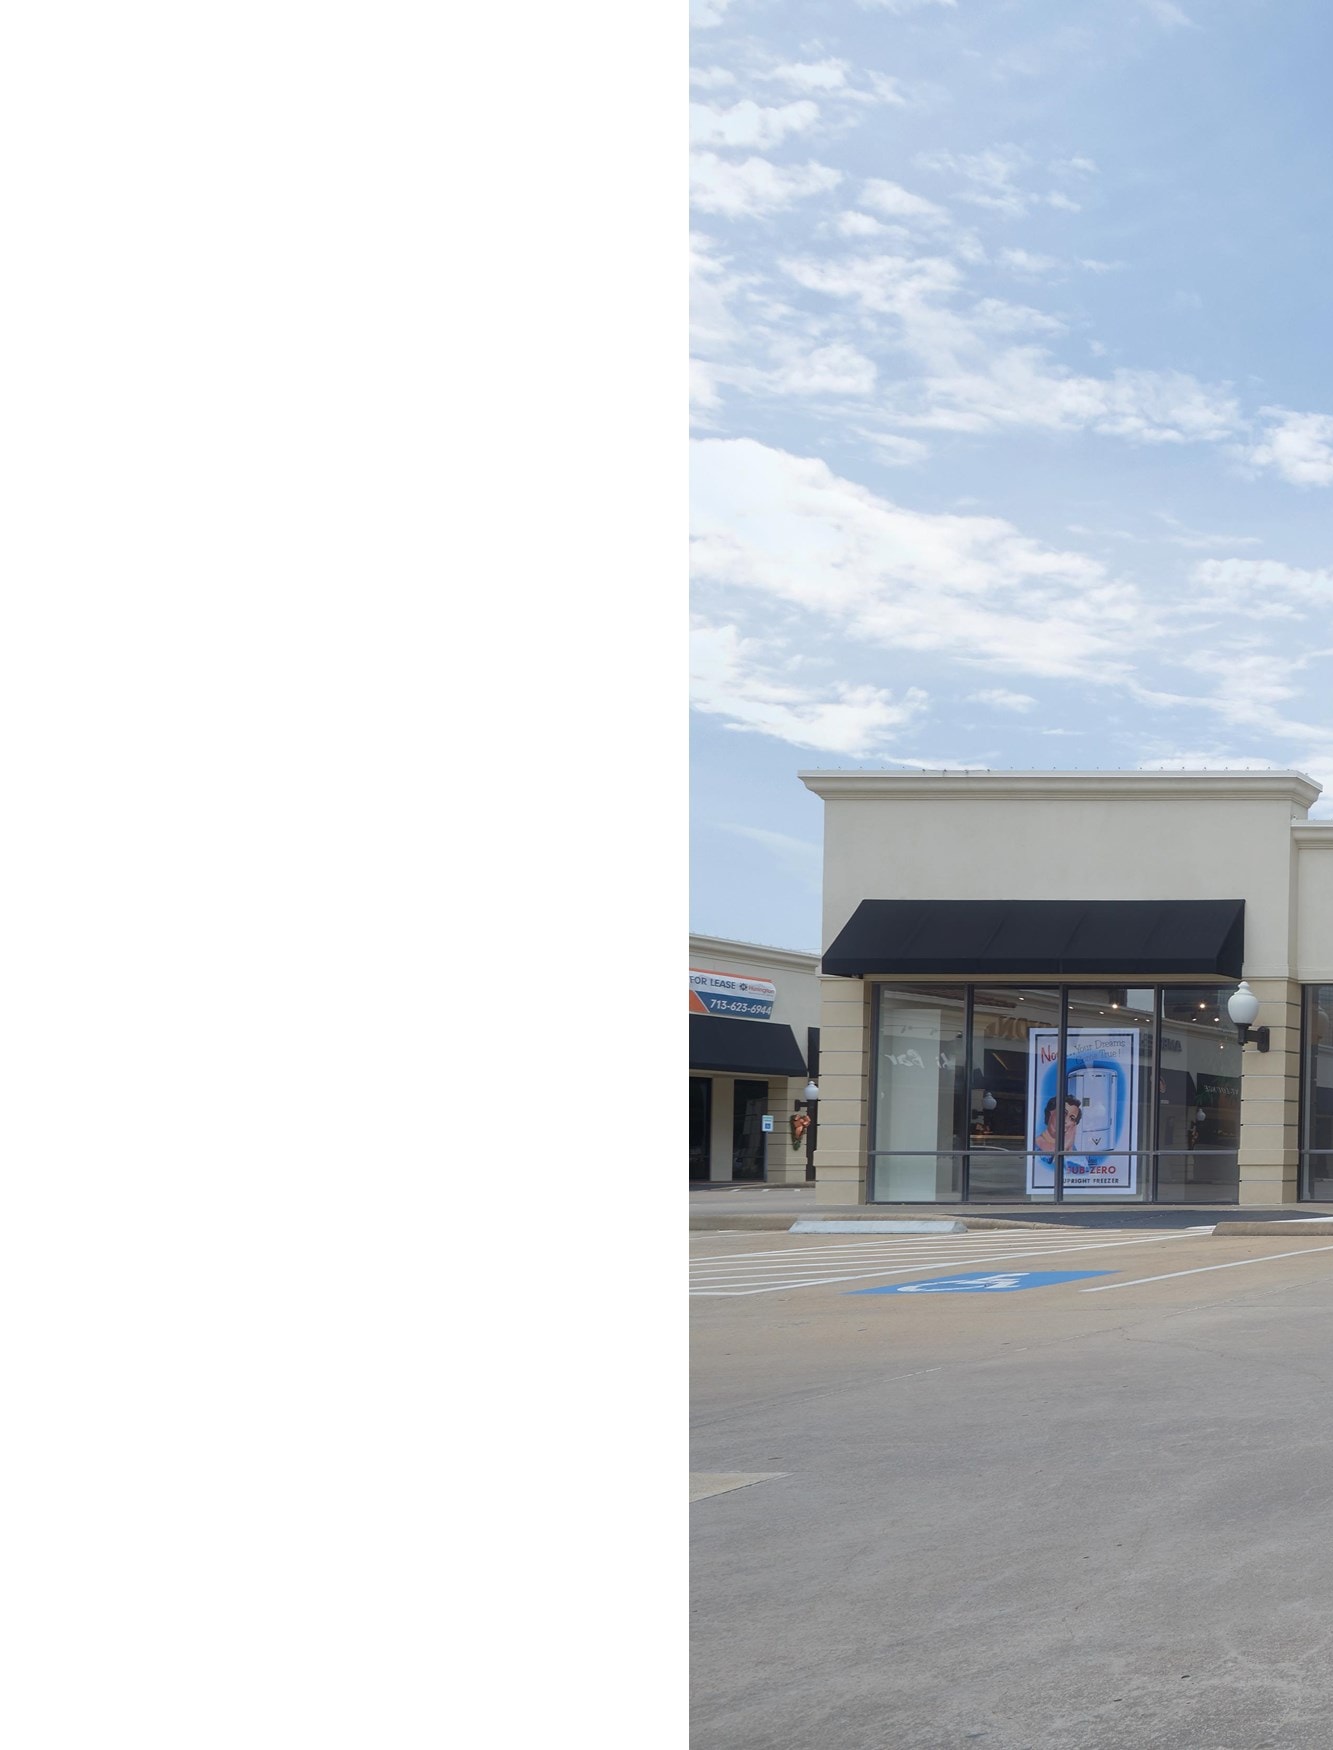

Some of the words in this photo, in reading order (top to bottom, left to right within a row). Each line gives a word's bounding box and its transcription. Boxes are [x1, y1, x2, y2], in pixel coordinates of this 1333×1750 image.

[689, 976, 708, 986] FOR
[710, 978, 736, 990] LEASE
[710, 999, 772, 1015] 713-623-6944
[1095, 1040, 1126, 1049] Dreams
[1041, 1044, 1059, 1064] No
[1066, 1165, 1116, 1174] SUB-ZERO
